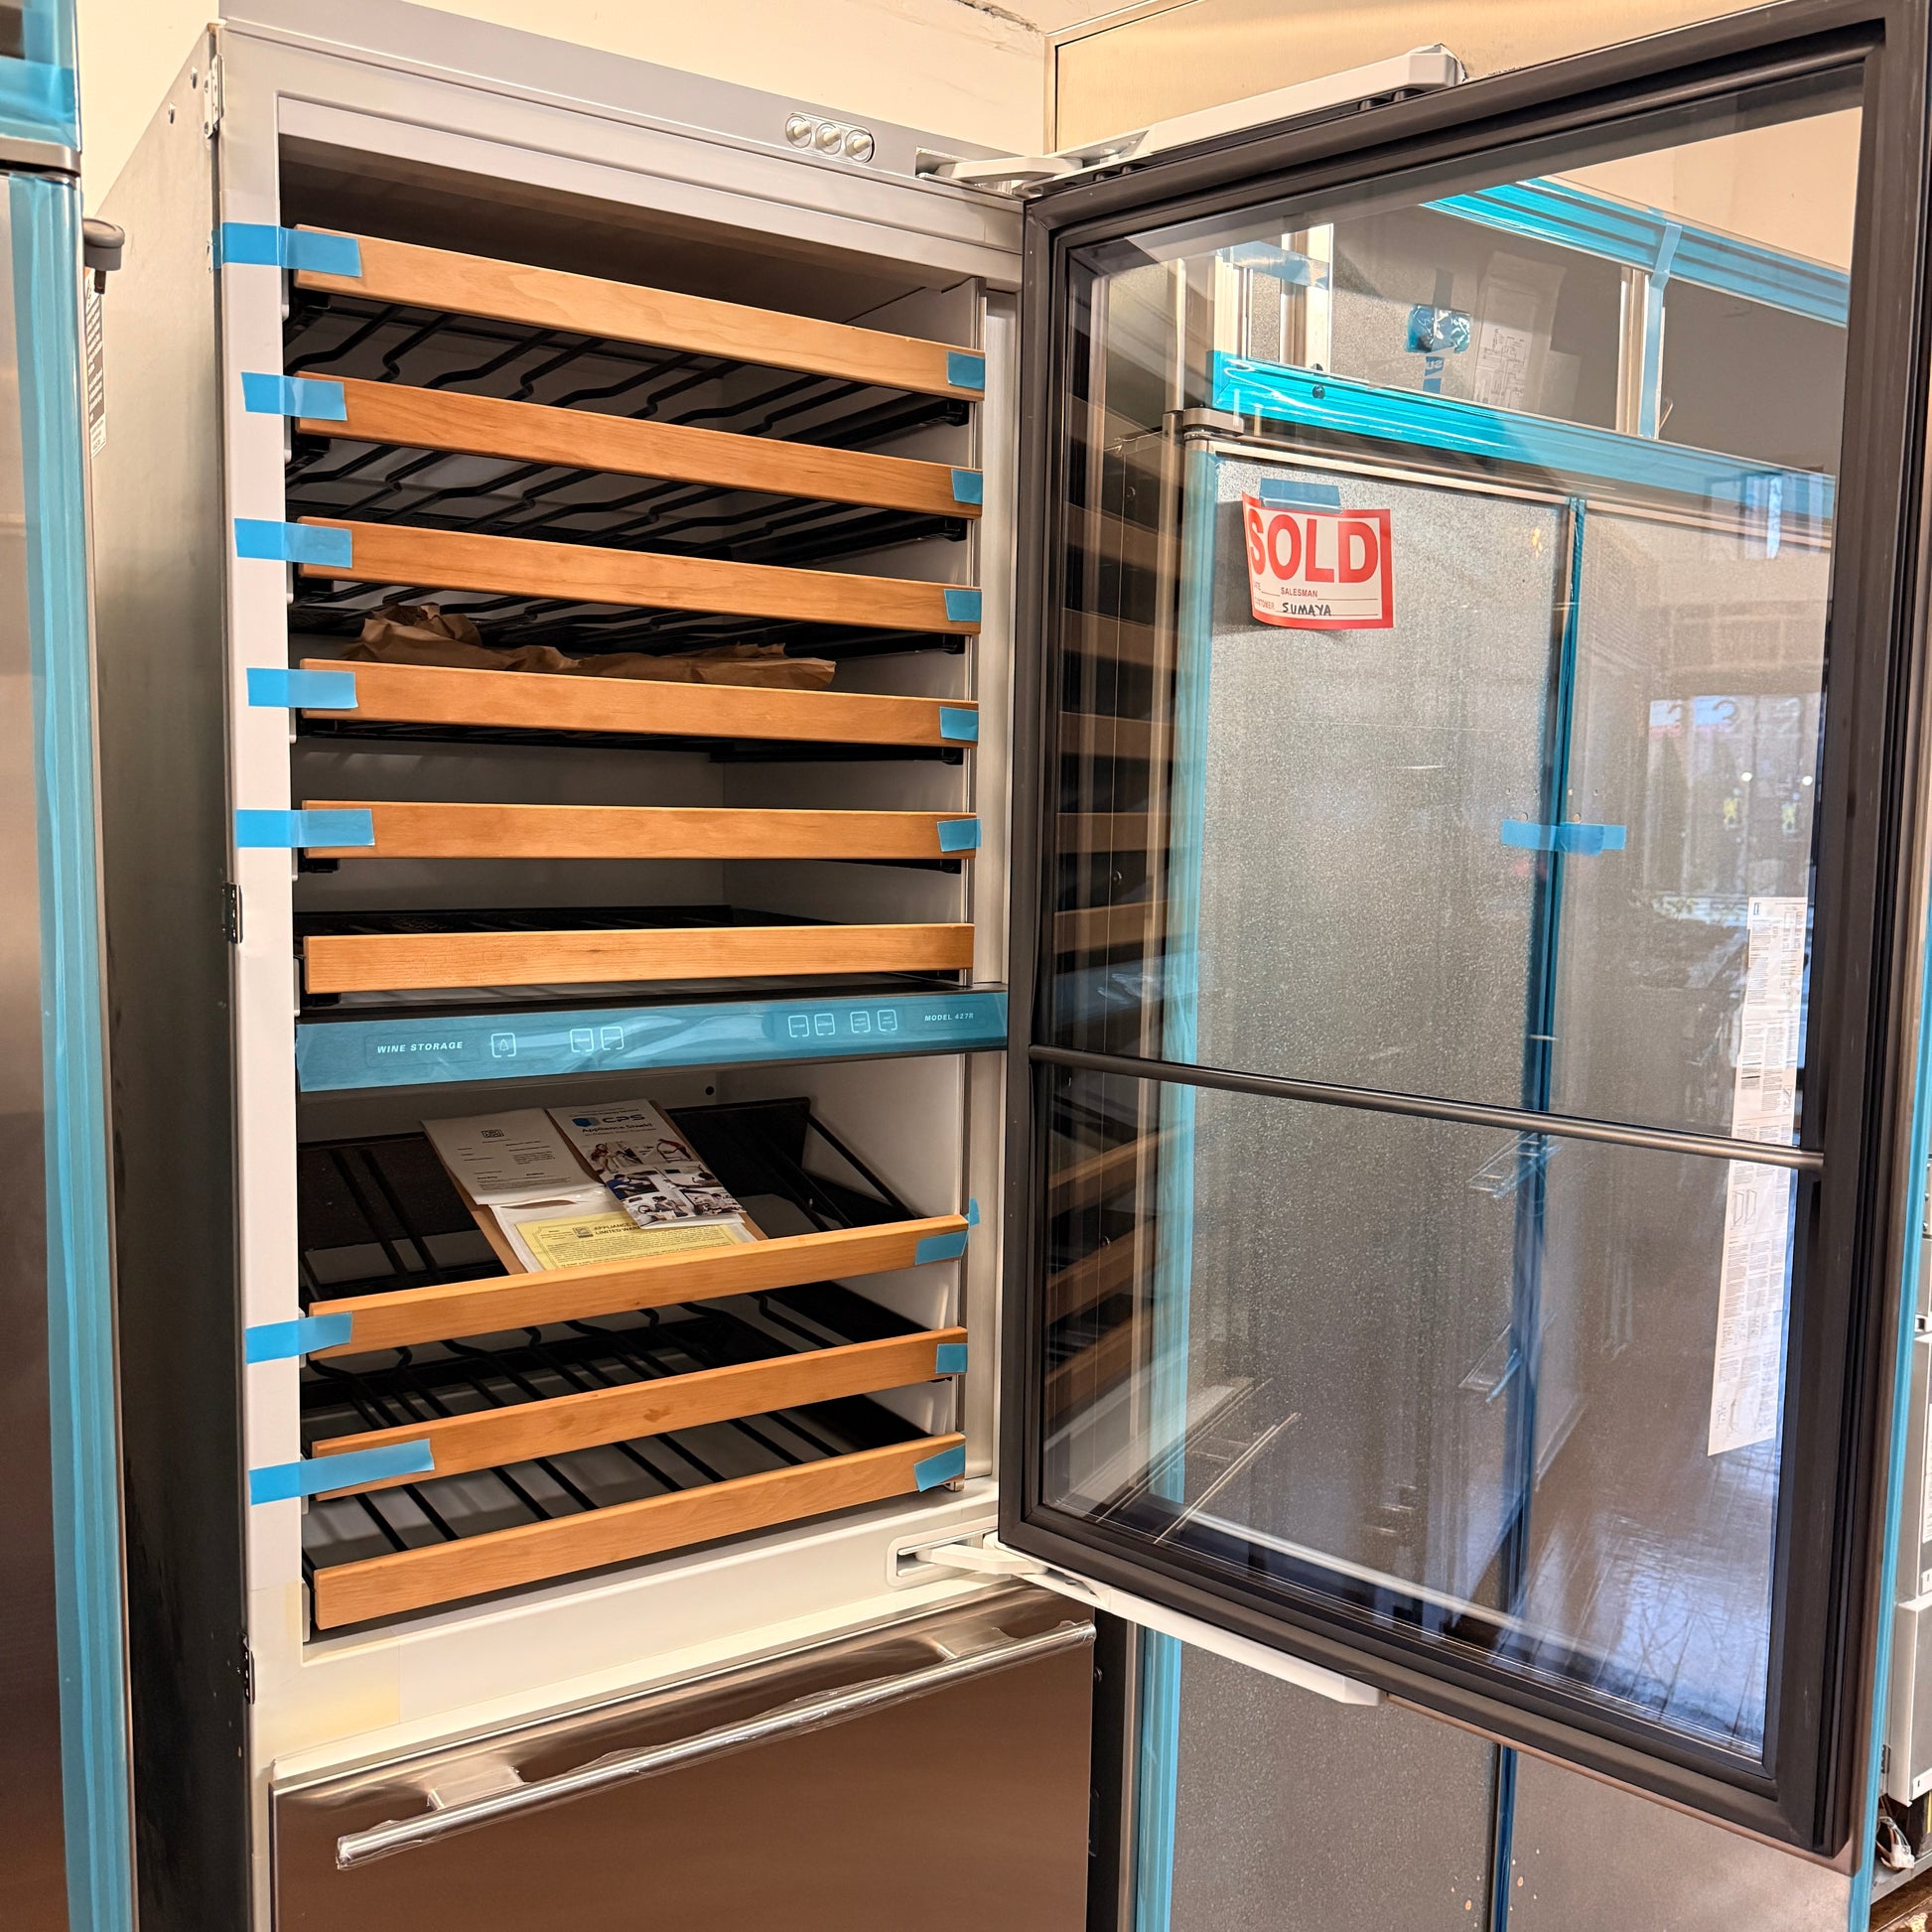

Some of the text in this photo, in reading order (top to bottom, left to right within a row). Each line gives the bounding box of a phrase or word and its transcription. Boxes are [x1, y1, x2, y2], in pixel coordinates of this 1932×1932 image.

[1247, 507, 1379, 584] SOLD
[1280, 587, 1318, 598] SALESMAN
[1282, 602, 1332, 618] SUMAYA
[377, 1041, 464, 1053] WINE STORAGE
